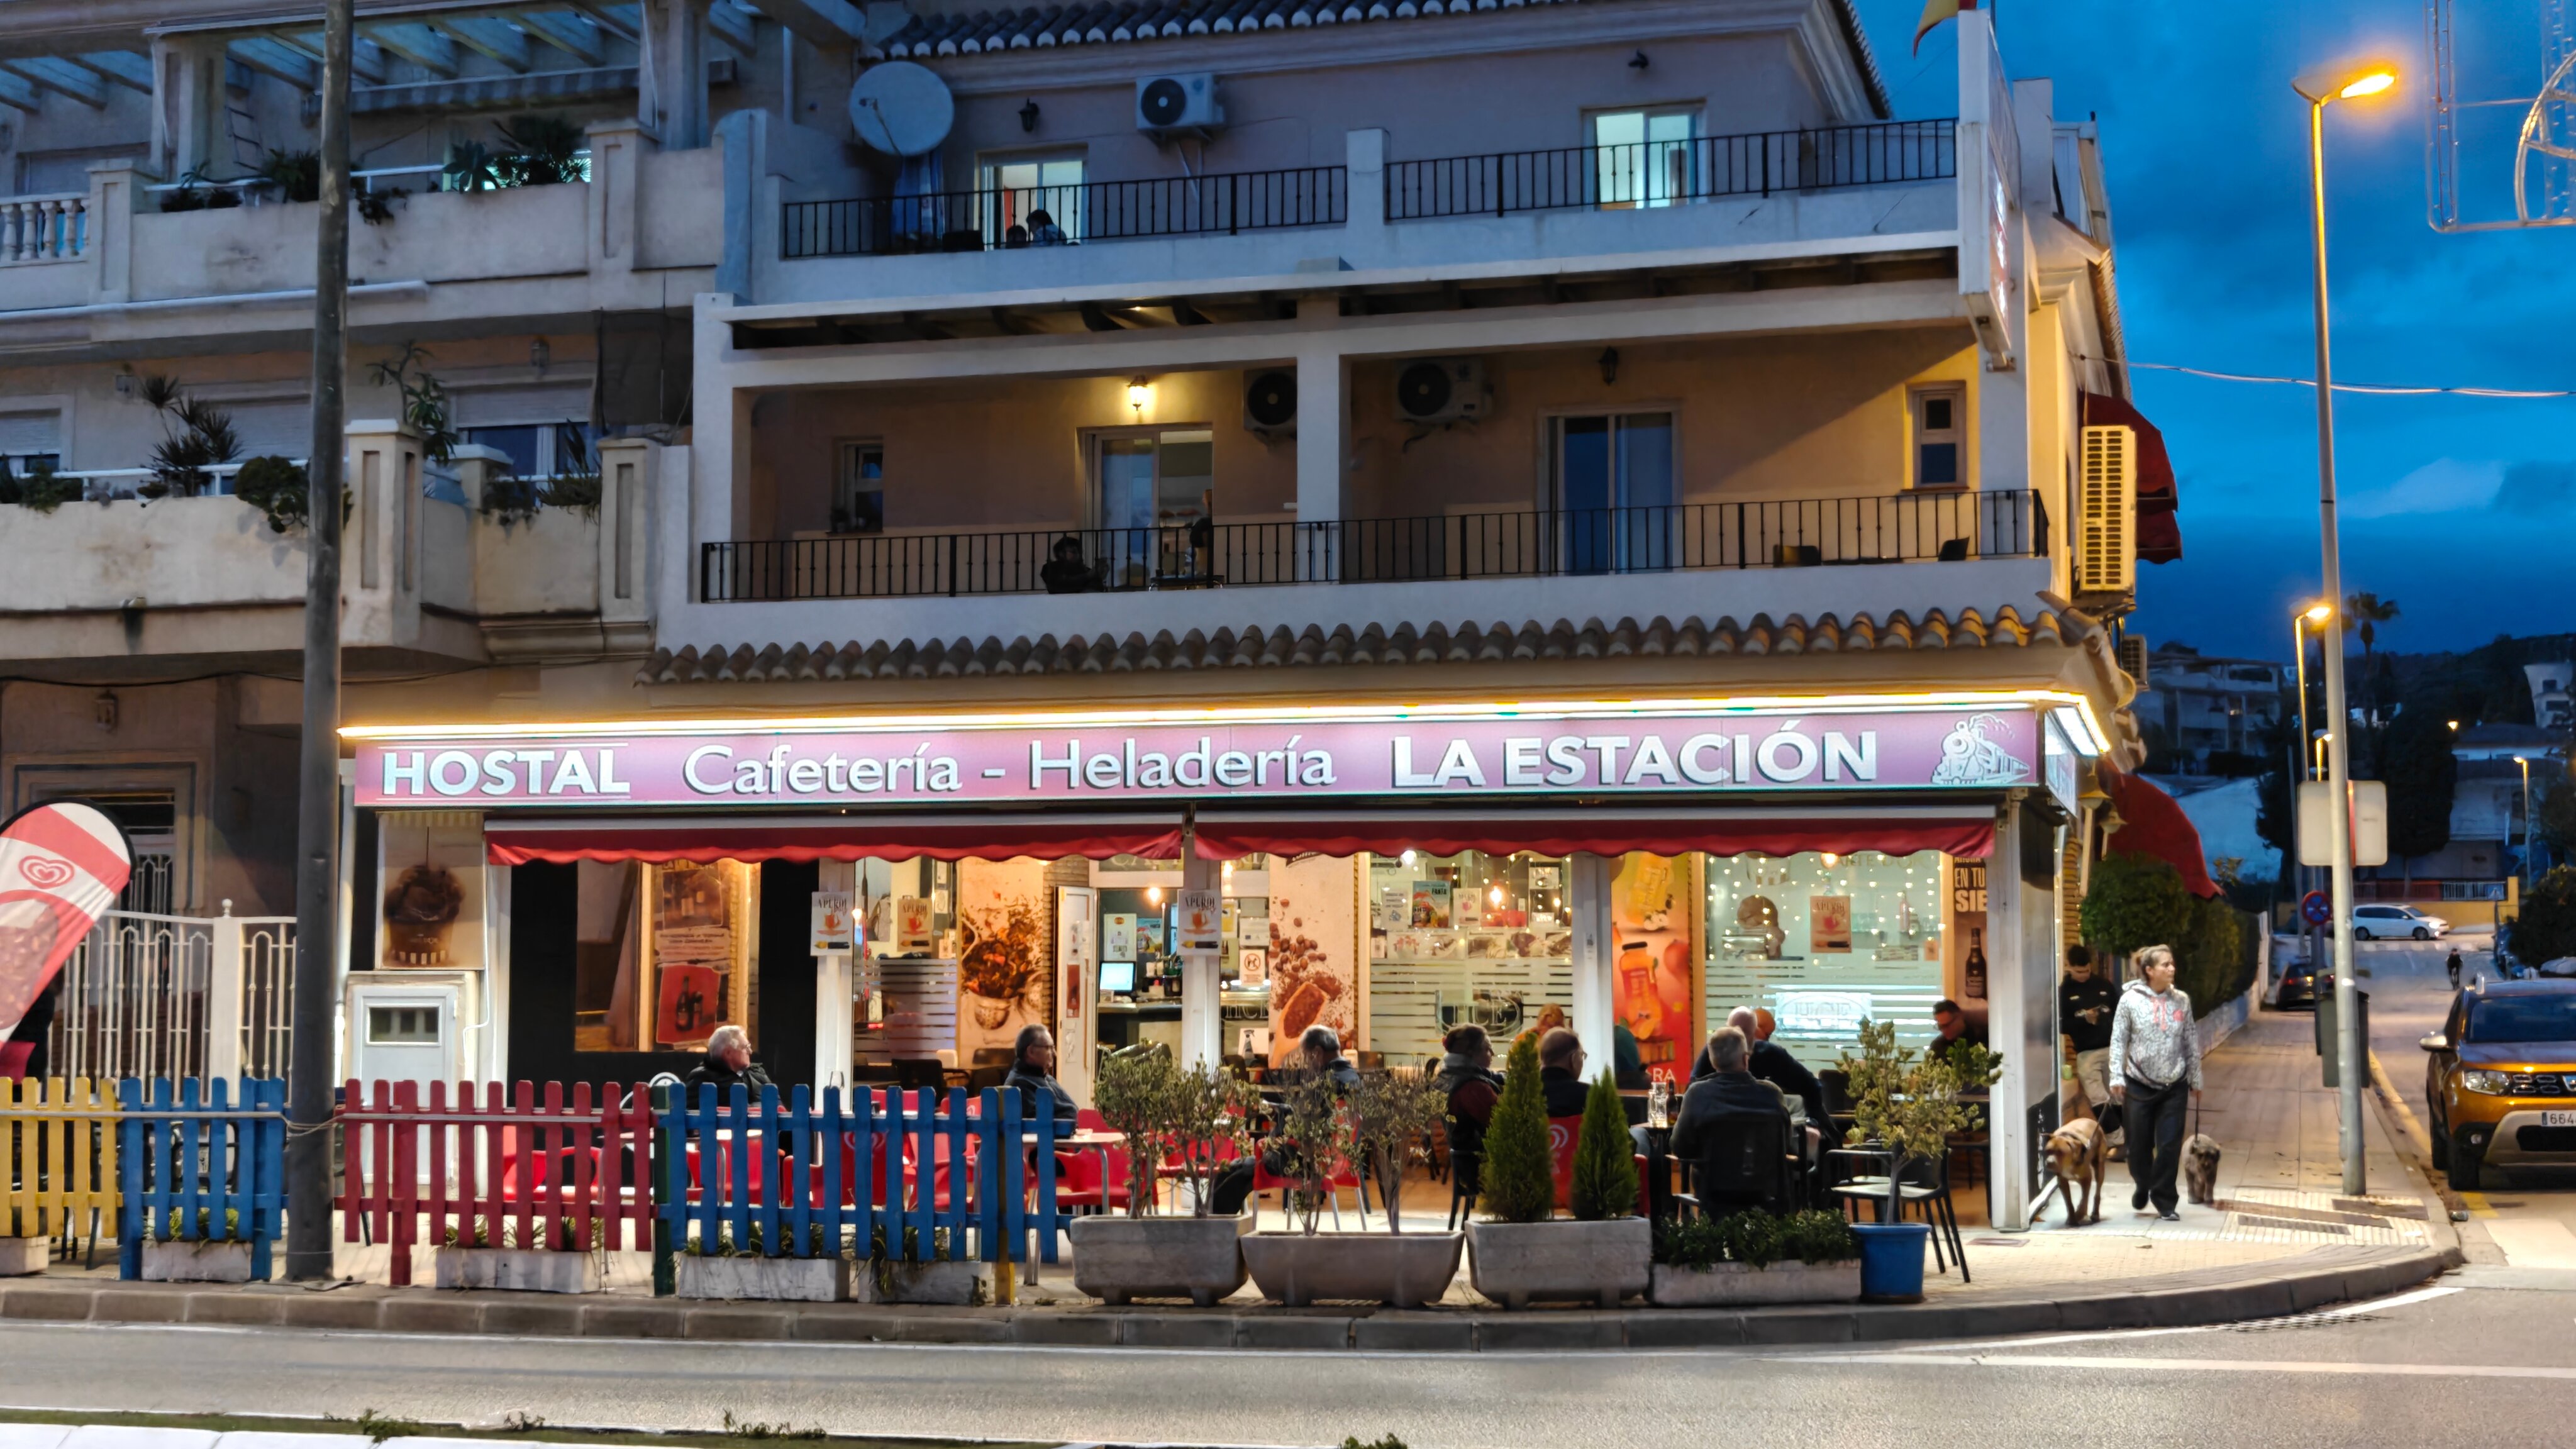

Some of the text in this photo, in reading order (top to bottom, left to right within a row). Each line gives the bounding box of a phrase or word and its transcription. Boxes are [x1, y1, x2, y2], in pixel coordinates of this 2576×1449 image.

[382, 720, 1877, 796] HOSTAL Cafetería - Heladería LA ESTACIÓN
[1954, 867, 1985, 888] EN TU
[1955, 889, 1987, 913] SIE
[1645, 1067, 1675, 1082] RA
[2550, 1113, 2576, 1124] 664
